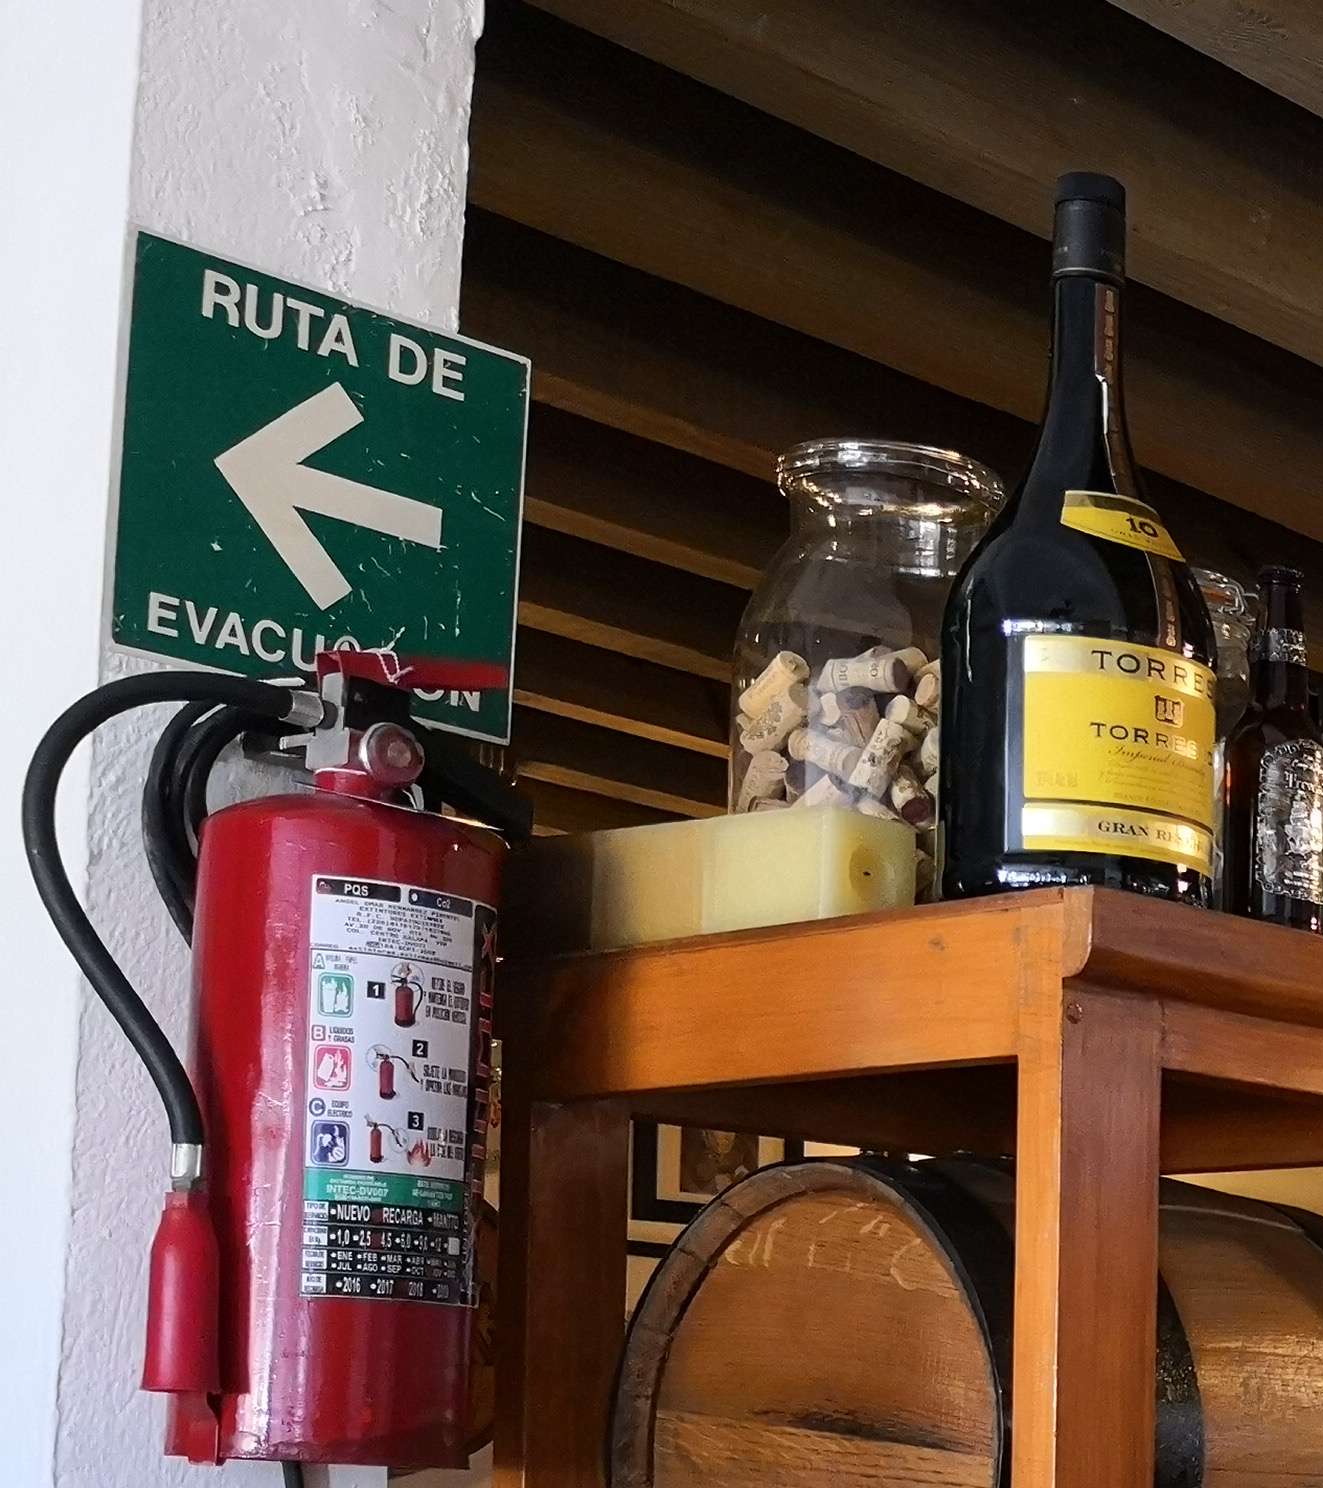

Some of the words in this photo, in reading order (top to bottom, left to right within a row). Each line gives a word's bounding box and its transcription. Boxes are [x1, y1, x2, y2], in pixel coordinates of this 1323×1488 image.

[201, 268, 359, 368] RUTA
[387, 332, 467, 402] DE
[1125, 516, 1159, 538] 10
[1091, 649, 1213, 699] TORRES
[1090, 722, 1198, 760] TORRES
[1097, 820, 1149, 837] GRAN
[344, 883, 369, 897] PQS
[313, 1026, 325, 1040] B
[311, 1099, 324, 1115] C
[337, 1205, 371, 1222] NUEVO
[382, 1208, 424, 1226] RECARGA
[337, 1252, 353, 1260] ENE
[363, 1253, 378, 1262] FEB
[387, 1255, 402, 1264] MAR
[337, 1263, 352, 1271] JUL
[363, 1264, 378, 1272] AGO
[387, 1266, 402, 1274] SEP
[343, 1277, 361, 1293] 2016
[377, 1279, 394, 1295] 2017
